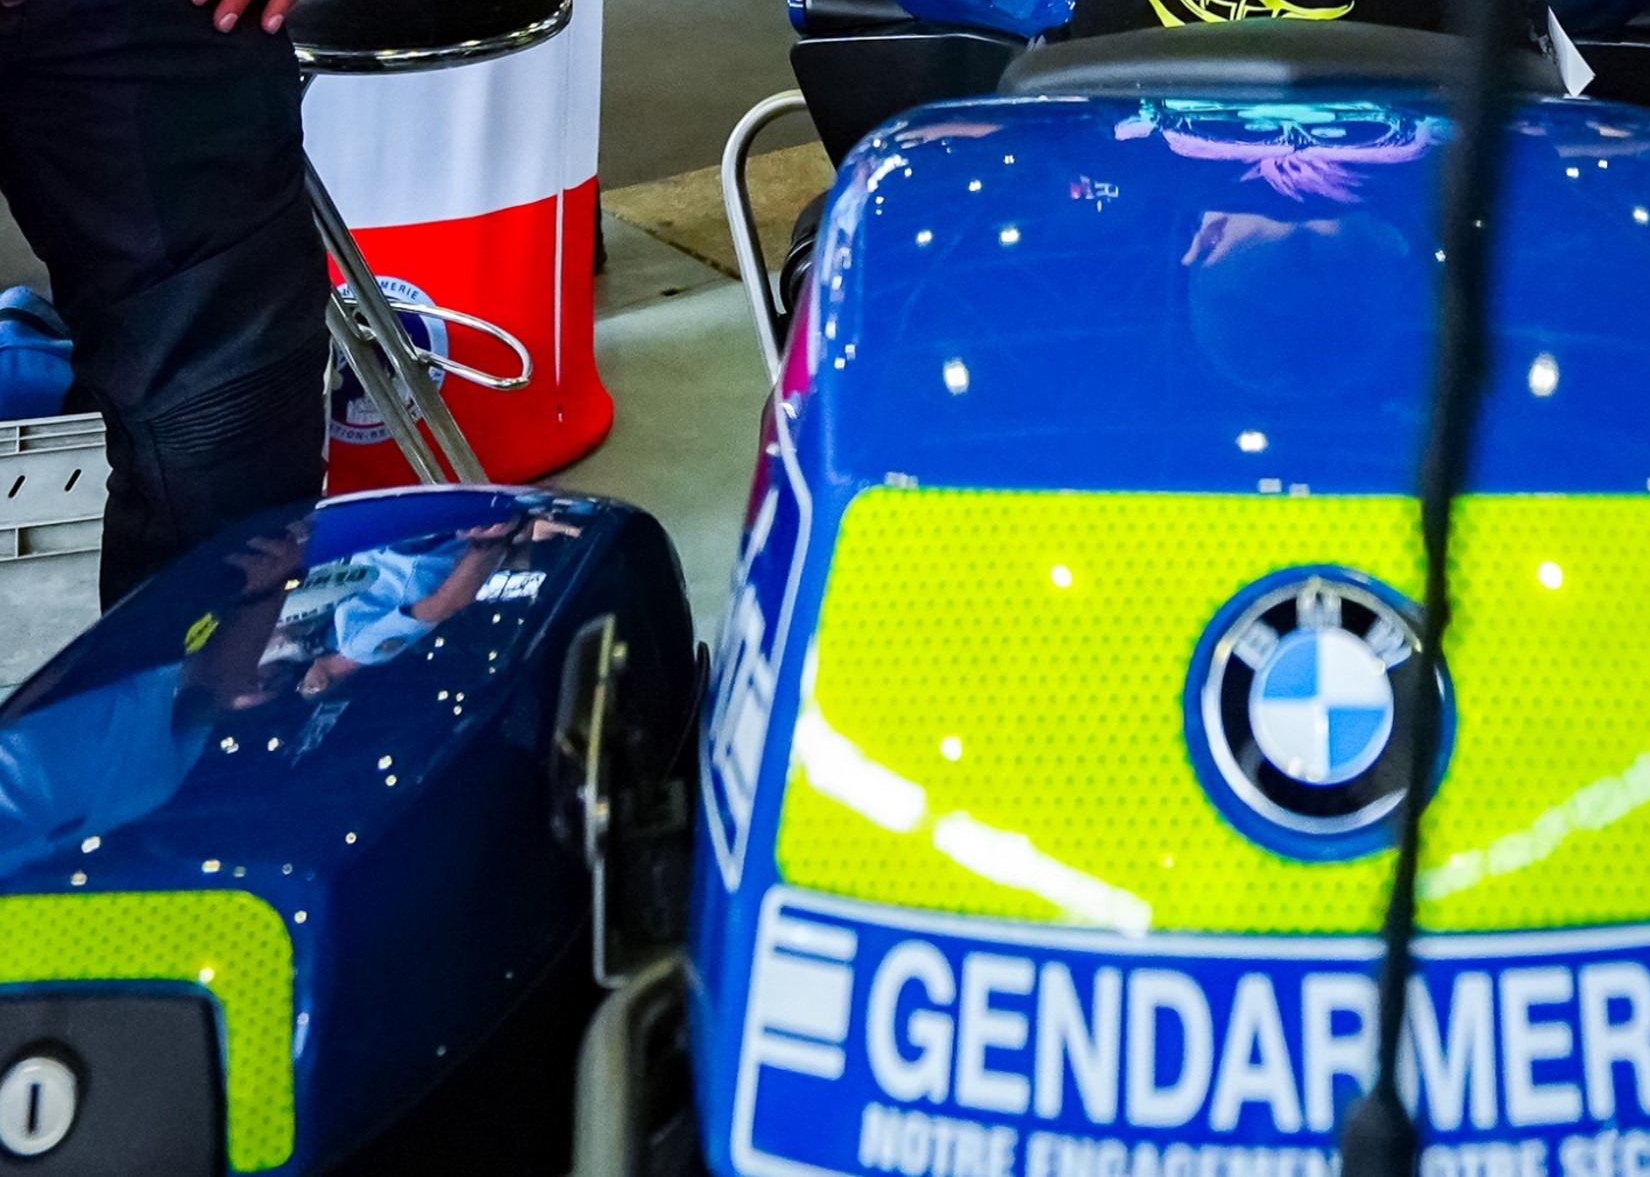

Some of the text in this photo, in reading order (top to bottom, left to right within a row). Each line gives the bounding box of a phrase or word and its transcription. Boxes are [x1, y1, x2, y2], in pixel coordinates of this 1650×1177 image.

[1233, 575, 1414, 673] BMW
[857, 1101, 1019, 1177] NOTRE
[1419, 1137, 1549, 1177] OTRE
